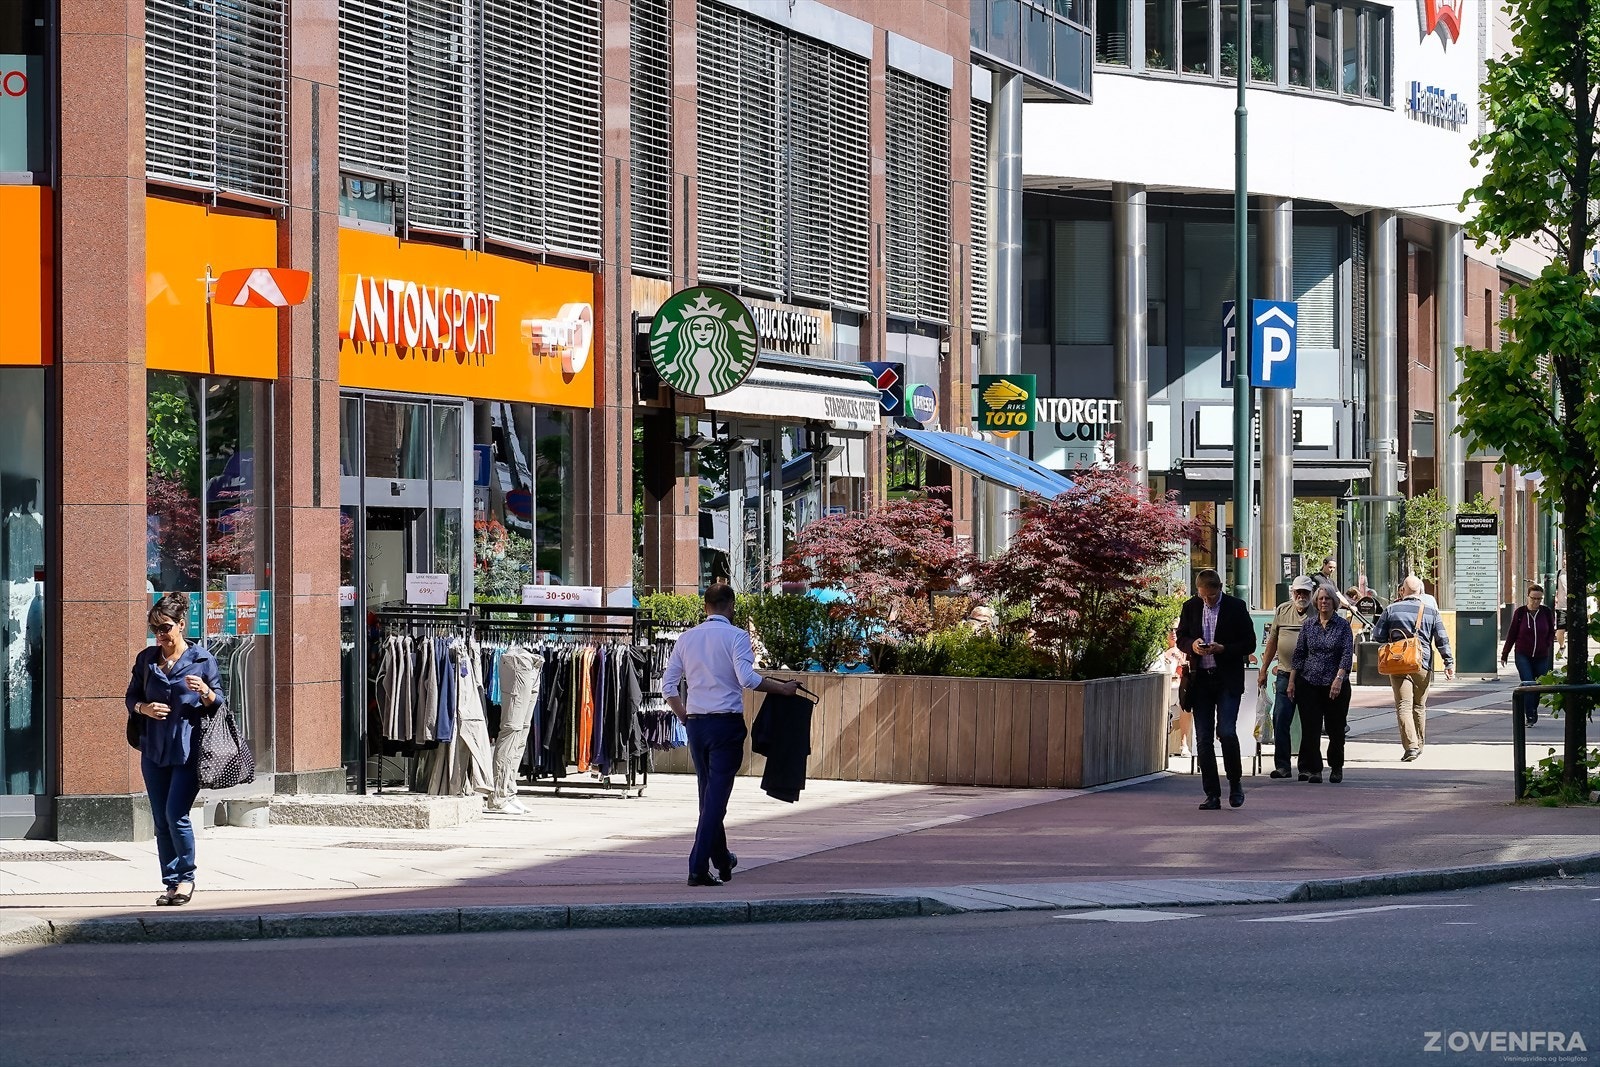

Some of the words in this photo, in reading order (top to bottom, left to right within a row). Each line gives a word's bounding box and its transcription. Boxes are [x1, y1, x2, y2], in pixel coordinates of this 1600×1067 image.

[790, 313, 821, 345] COFFEE
[1262, 327, 1291, 381] P
[824, 396, 859, 420] STARBUCKS
[859, 400, 876, 421] COFFEE
[986, 411, 1028, 426] TOTO
[545, 591, 580, 601] 30-50%
